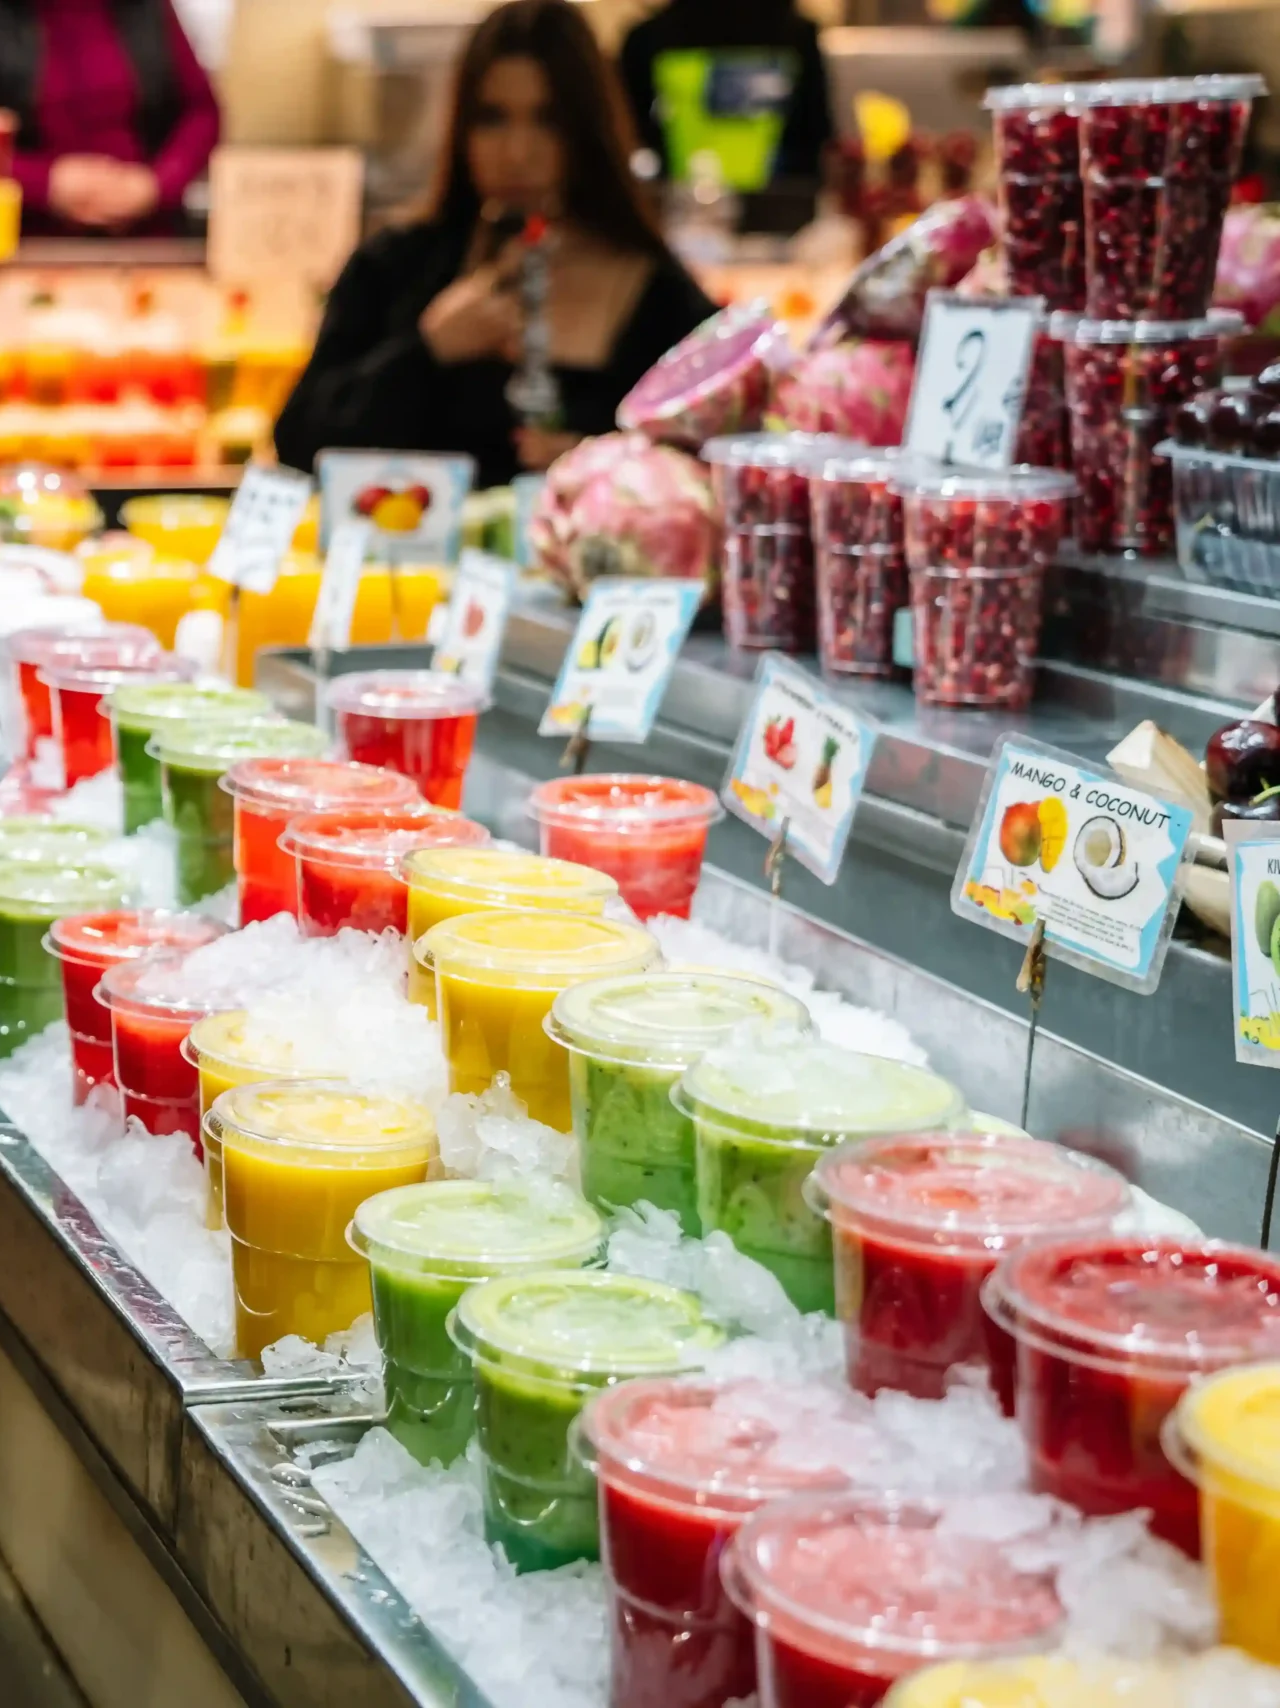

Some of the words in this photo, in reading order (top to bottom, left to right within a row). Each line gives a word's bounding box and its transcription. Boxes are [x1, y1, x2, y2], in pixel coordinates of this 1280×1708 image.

[1011, 762, 1066, 792] MANGO
[1069, 783, 1081, 800] &
[1085, 789, 1172, 829] COCONUT
